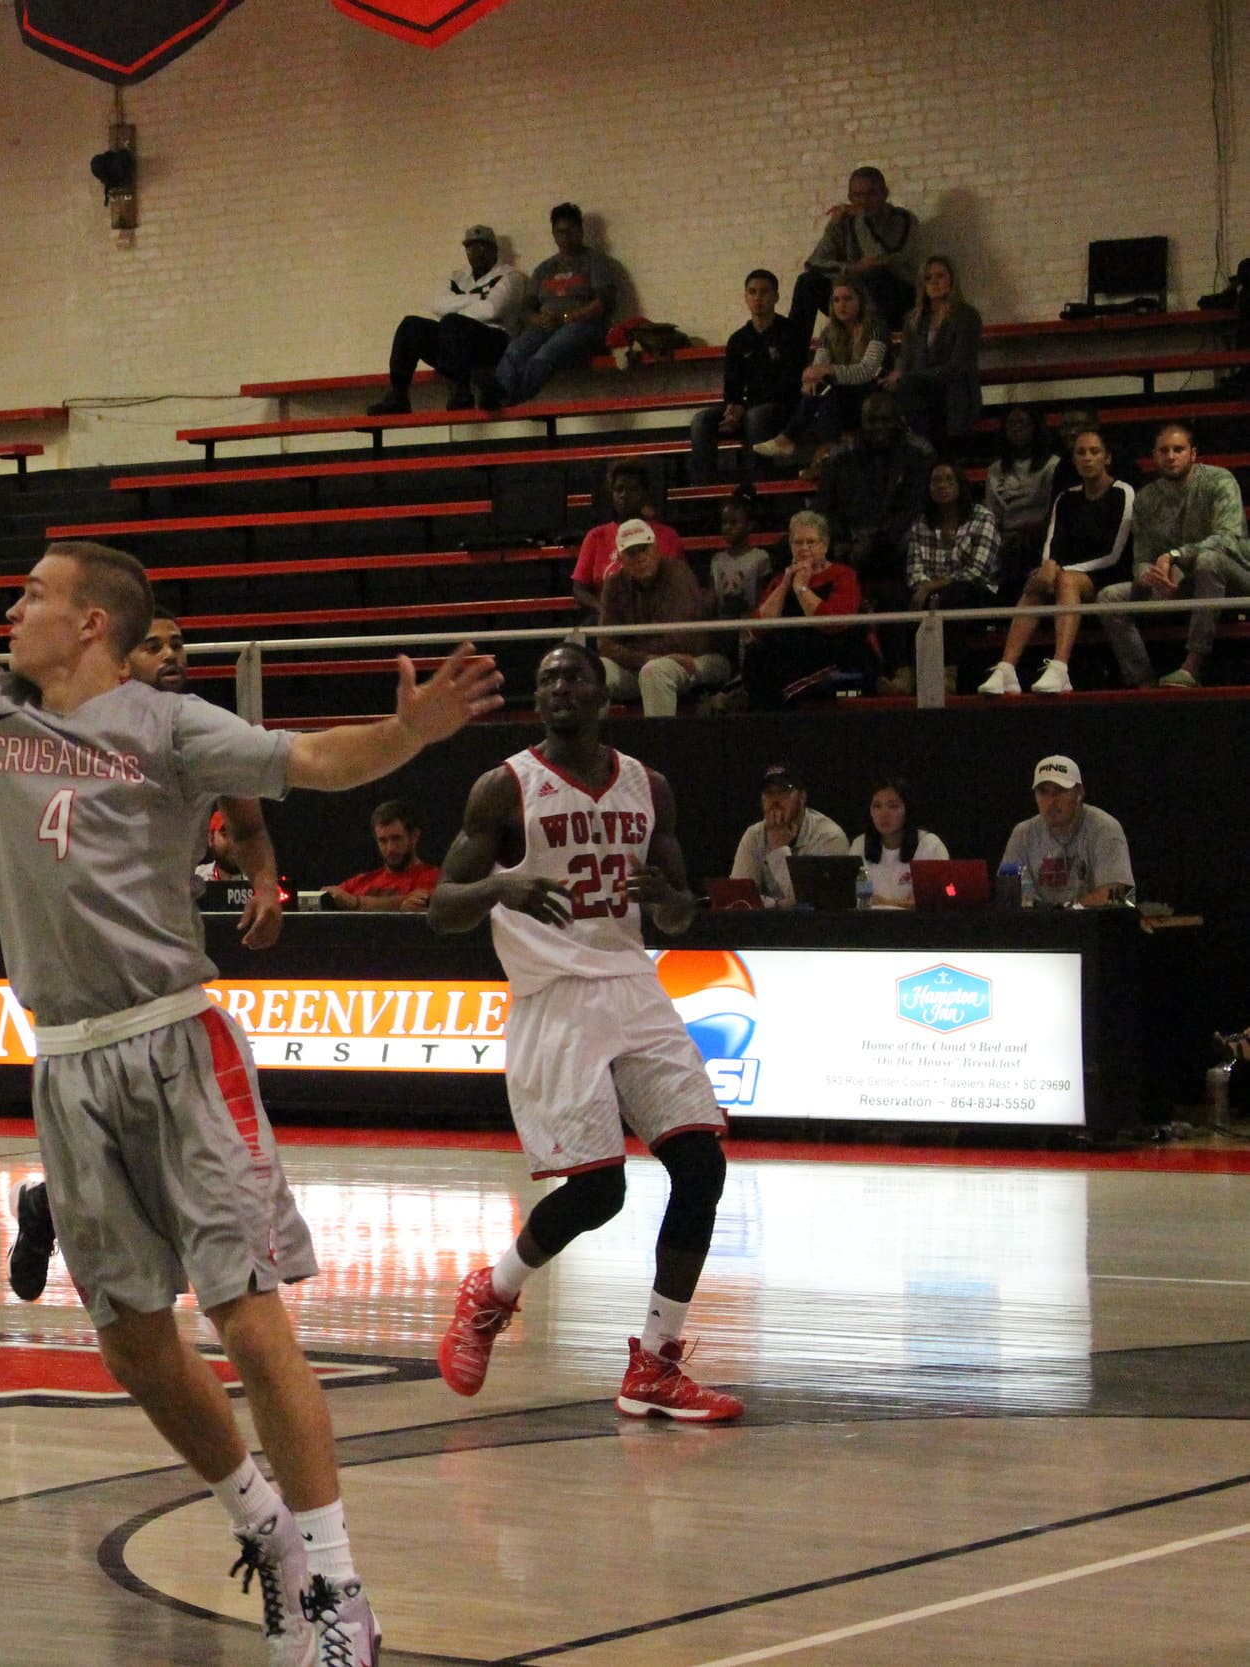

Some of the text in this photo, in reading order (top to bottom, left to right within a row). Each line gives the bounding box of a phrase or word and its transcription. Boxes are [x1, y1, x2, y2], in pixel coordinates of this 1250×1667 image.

[38, 787, 76, 861] 4
[539, 810, 648, 848] WOLVES
[567, 853, 629, 919] 23
[904, 984, 985, 1009] Hampton
[923, 1005, 964, 1024] Inn
[861, 1040, 894, 1051] Home
[898, 1041, 910, 1053] of
[911, 1041, 928, 1052] the
[932, 1042, 966, 1053] Cloud
[979, 1042, 1001, 1053] Bed
[1004, 1042, 1028, 1054] and
[942, 1078, 985, 1089] Travelers
[988, 1078, 1011, 1089] Rest
[1023, 1079, 1037, 1090] SC
[1040, 1080, 1071, 1091] 29690
[859, 1094, 1036, 1110] Reservation 864-834-5550
